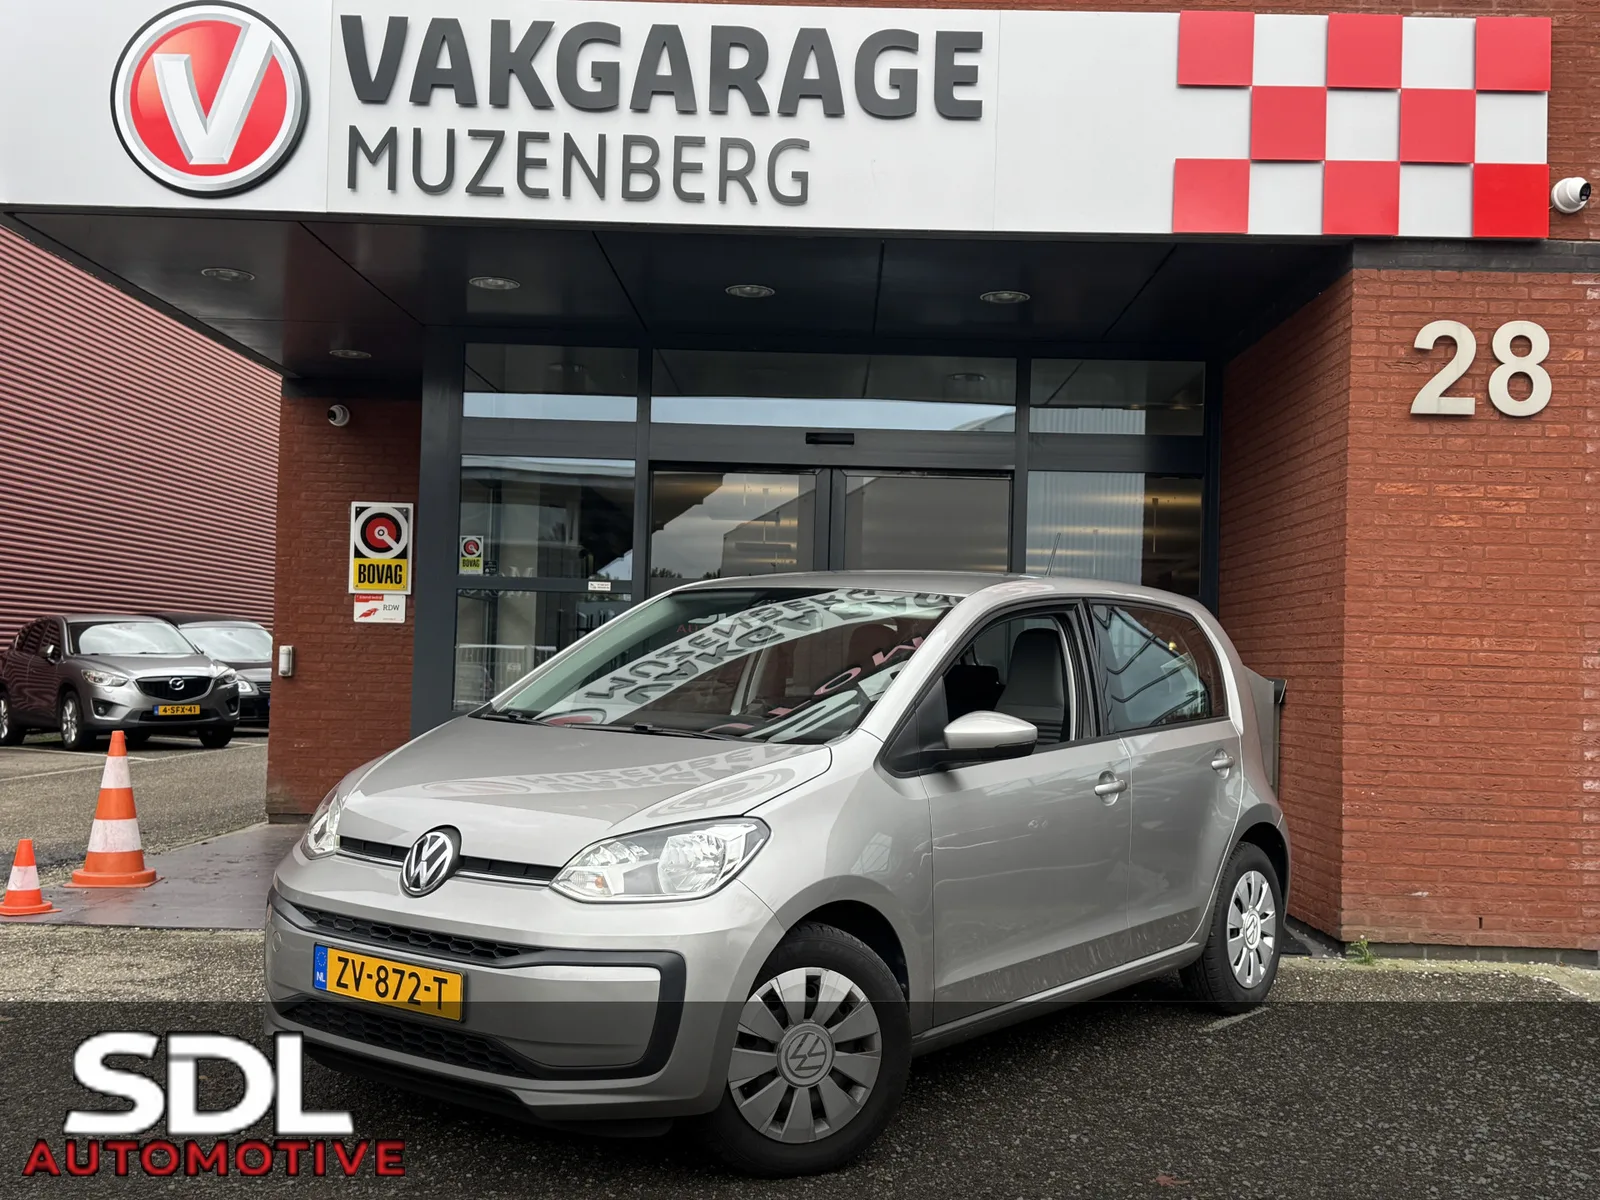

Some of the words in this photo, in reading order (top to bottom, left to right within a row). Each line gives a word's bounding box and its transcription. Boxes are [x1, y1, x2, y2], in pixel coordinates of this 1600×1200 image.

[340, 14, 983, 121] VAKGARAGE
[347, 125, 811, 206] MUZENBERG
[1410, 319, 1553, 417] 28
[357, 563, 403, 585] BOVAG
[461, 558, 481, 568] BOVAG
[382, 603, 400, 612] RDW
[162, 706, 196, 714] 4-SFX-41
[316, 970, 326, 983] NL
[335, 955, 449, 1011] ZV-872-T
